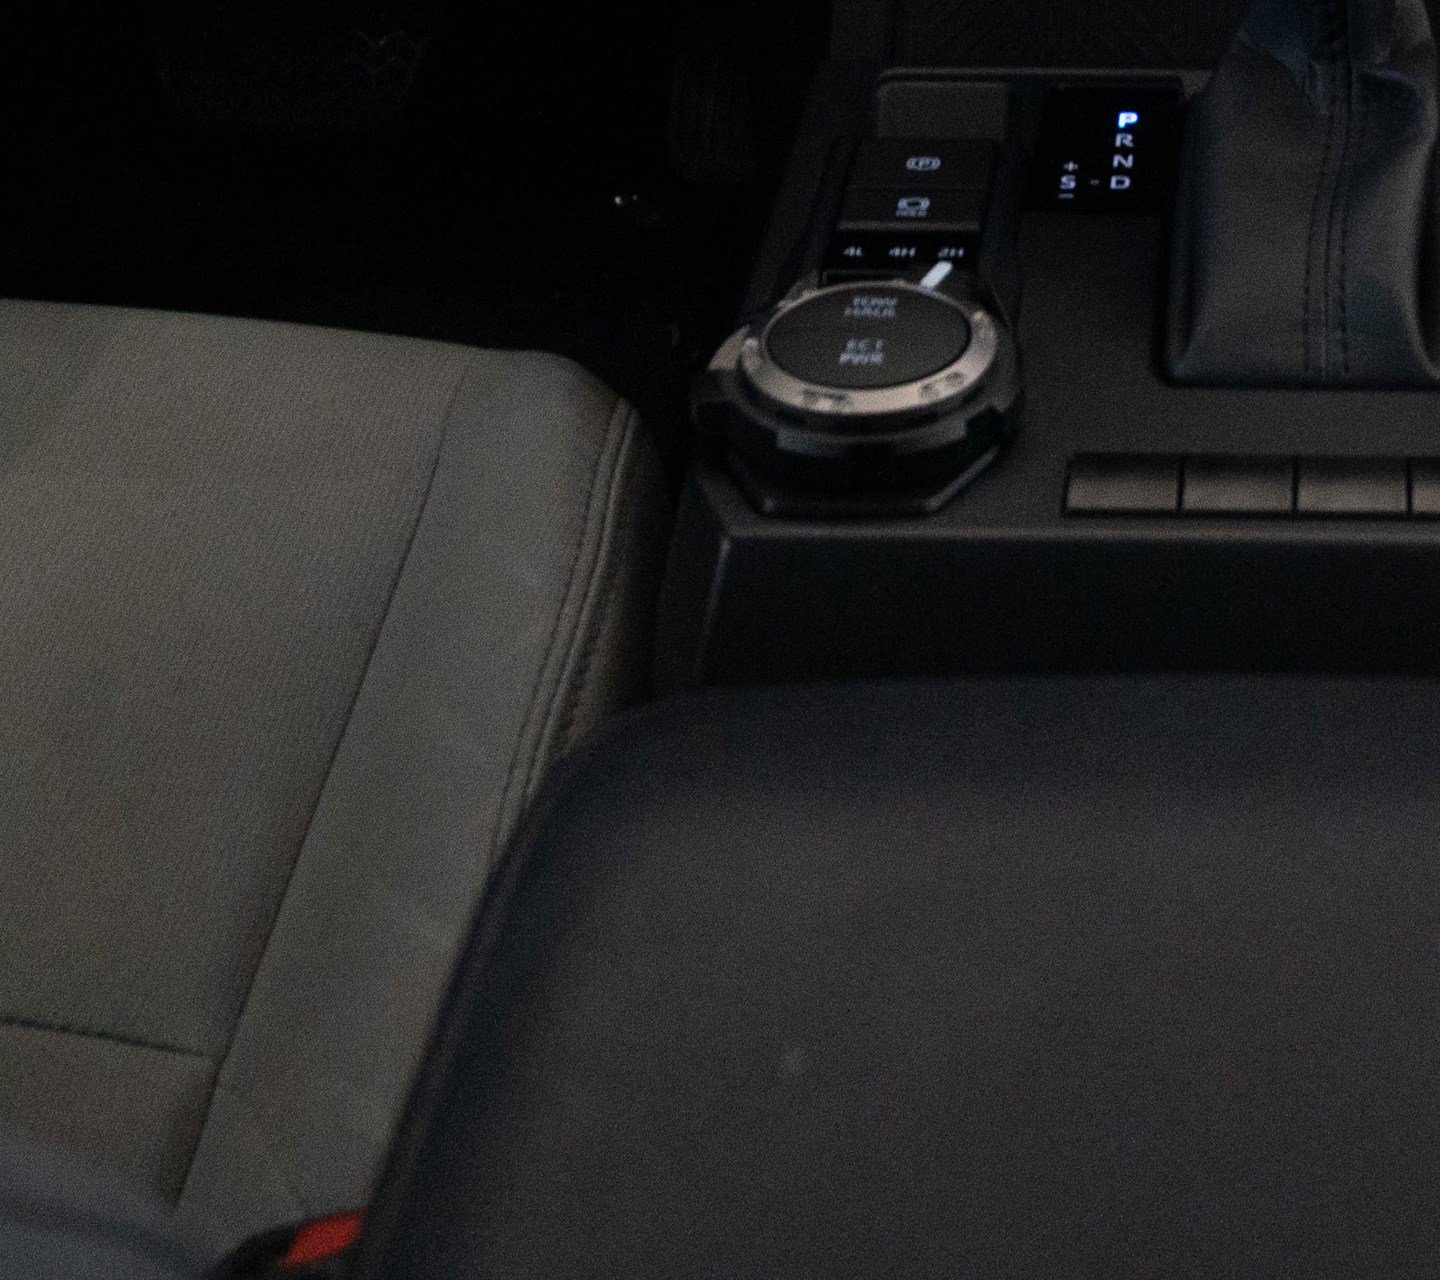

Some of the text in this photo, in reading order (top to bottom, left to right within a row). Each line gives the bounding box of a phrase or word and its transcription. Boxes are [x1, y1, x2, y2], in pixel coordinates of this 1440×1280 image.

[1117, 111, 1139, 129] P
[1114, 132, 1135, 149] R
[1112, 153, 1134, 169] N
[1058, 174, 1077, 191] S
[1109, 174, 1132, 191] D
